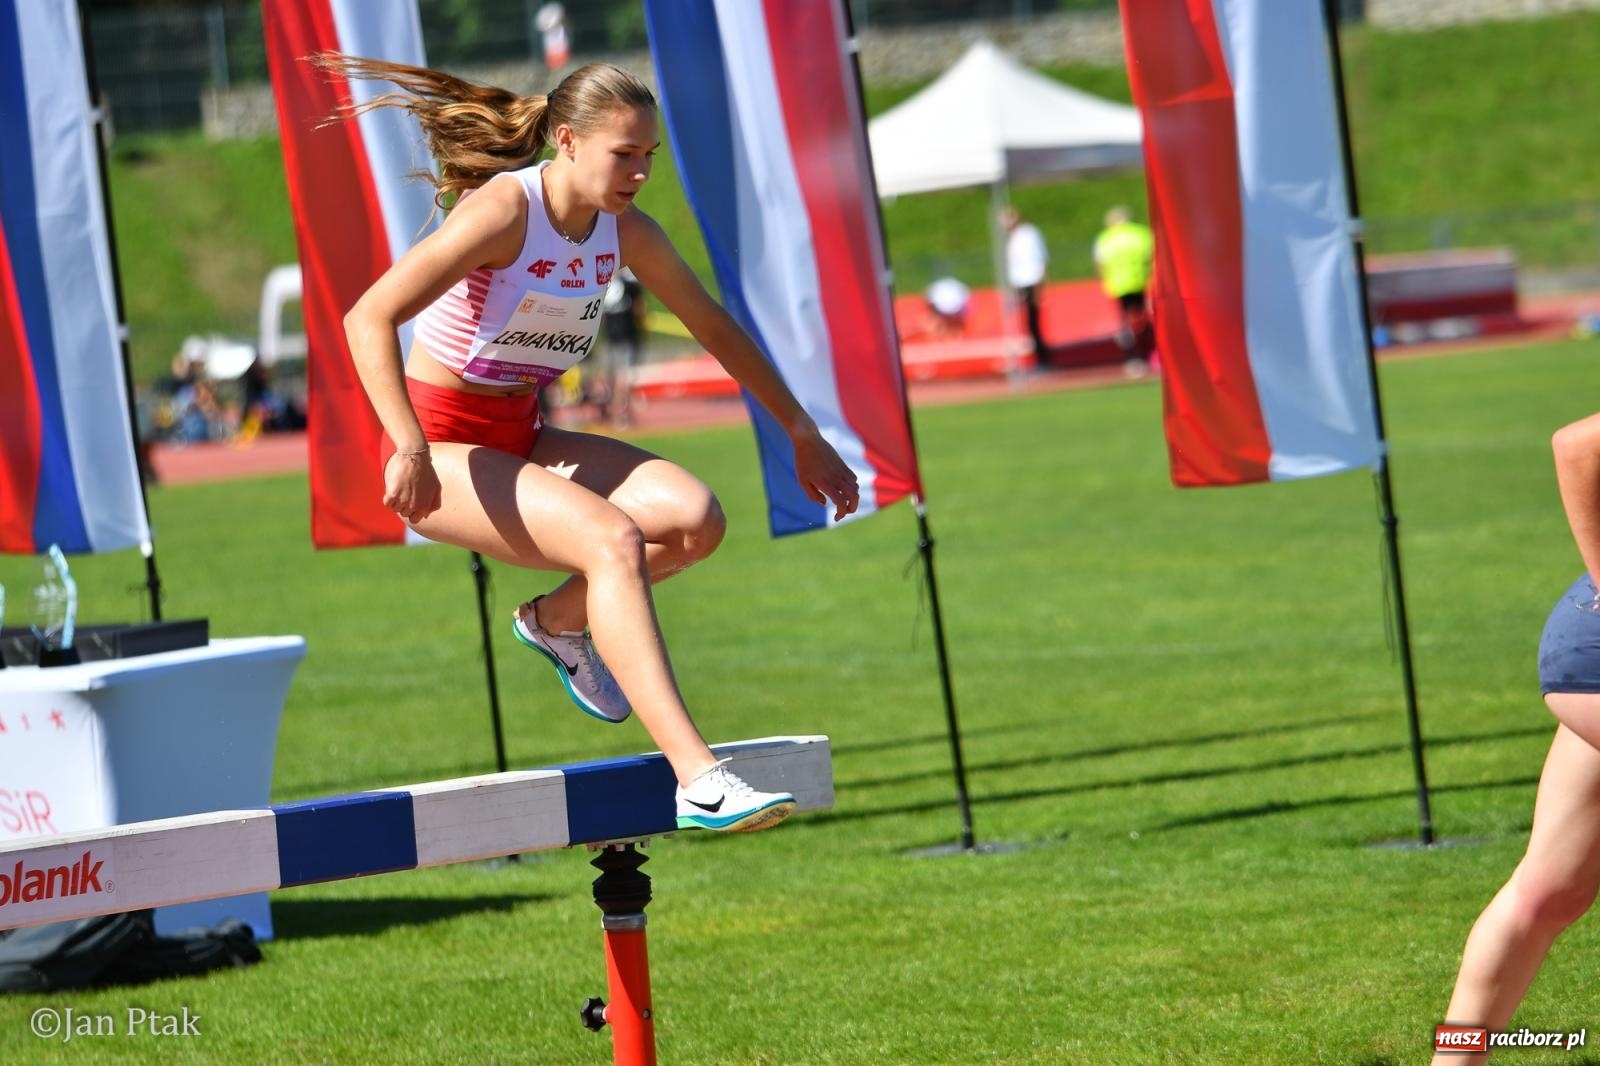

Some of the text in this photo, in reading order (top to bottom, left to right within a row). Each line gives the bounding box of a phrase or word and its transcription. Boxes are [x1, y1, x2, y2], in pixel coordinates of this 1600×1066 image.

[527, 259, 557, 278] 4F
[560, 279, 585, 288] ORLEN
[579, 299, 601, 320] 18
[491, 330, 593, 355] LEMAŃSKA
